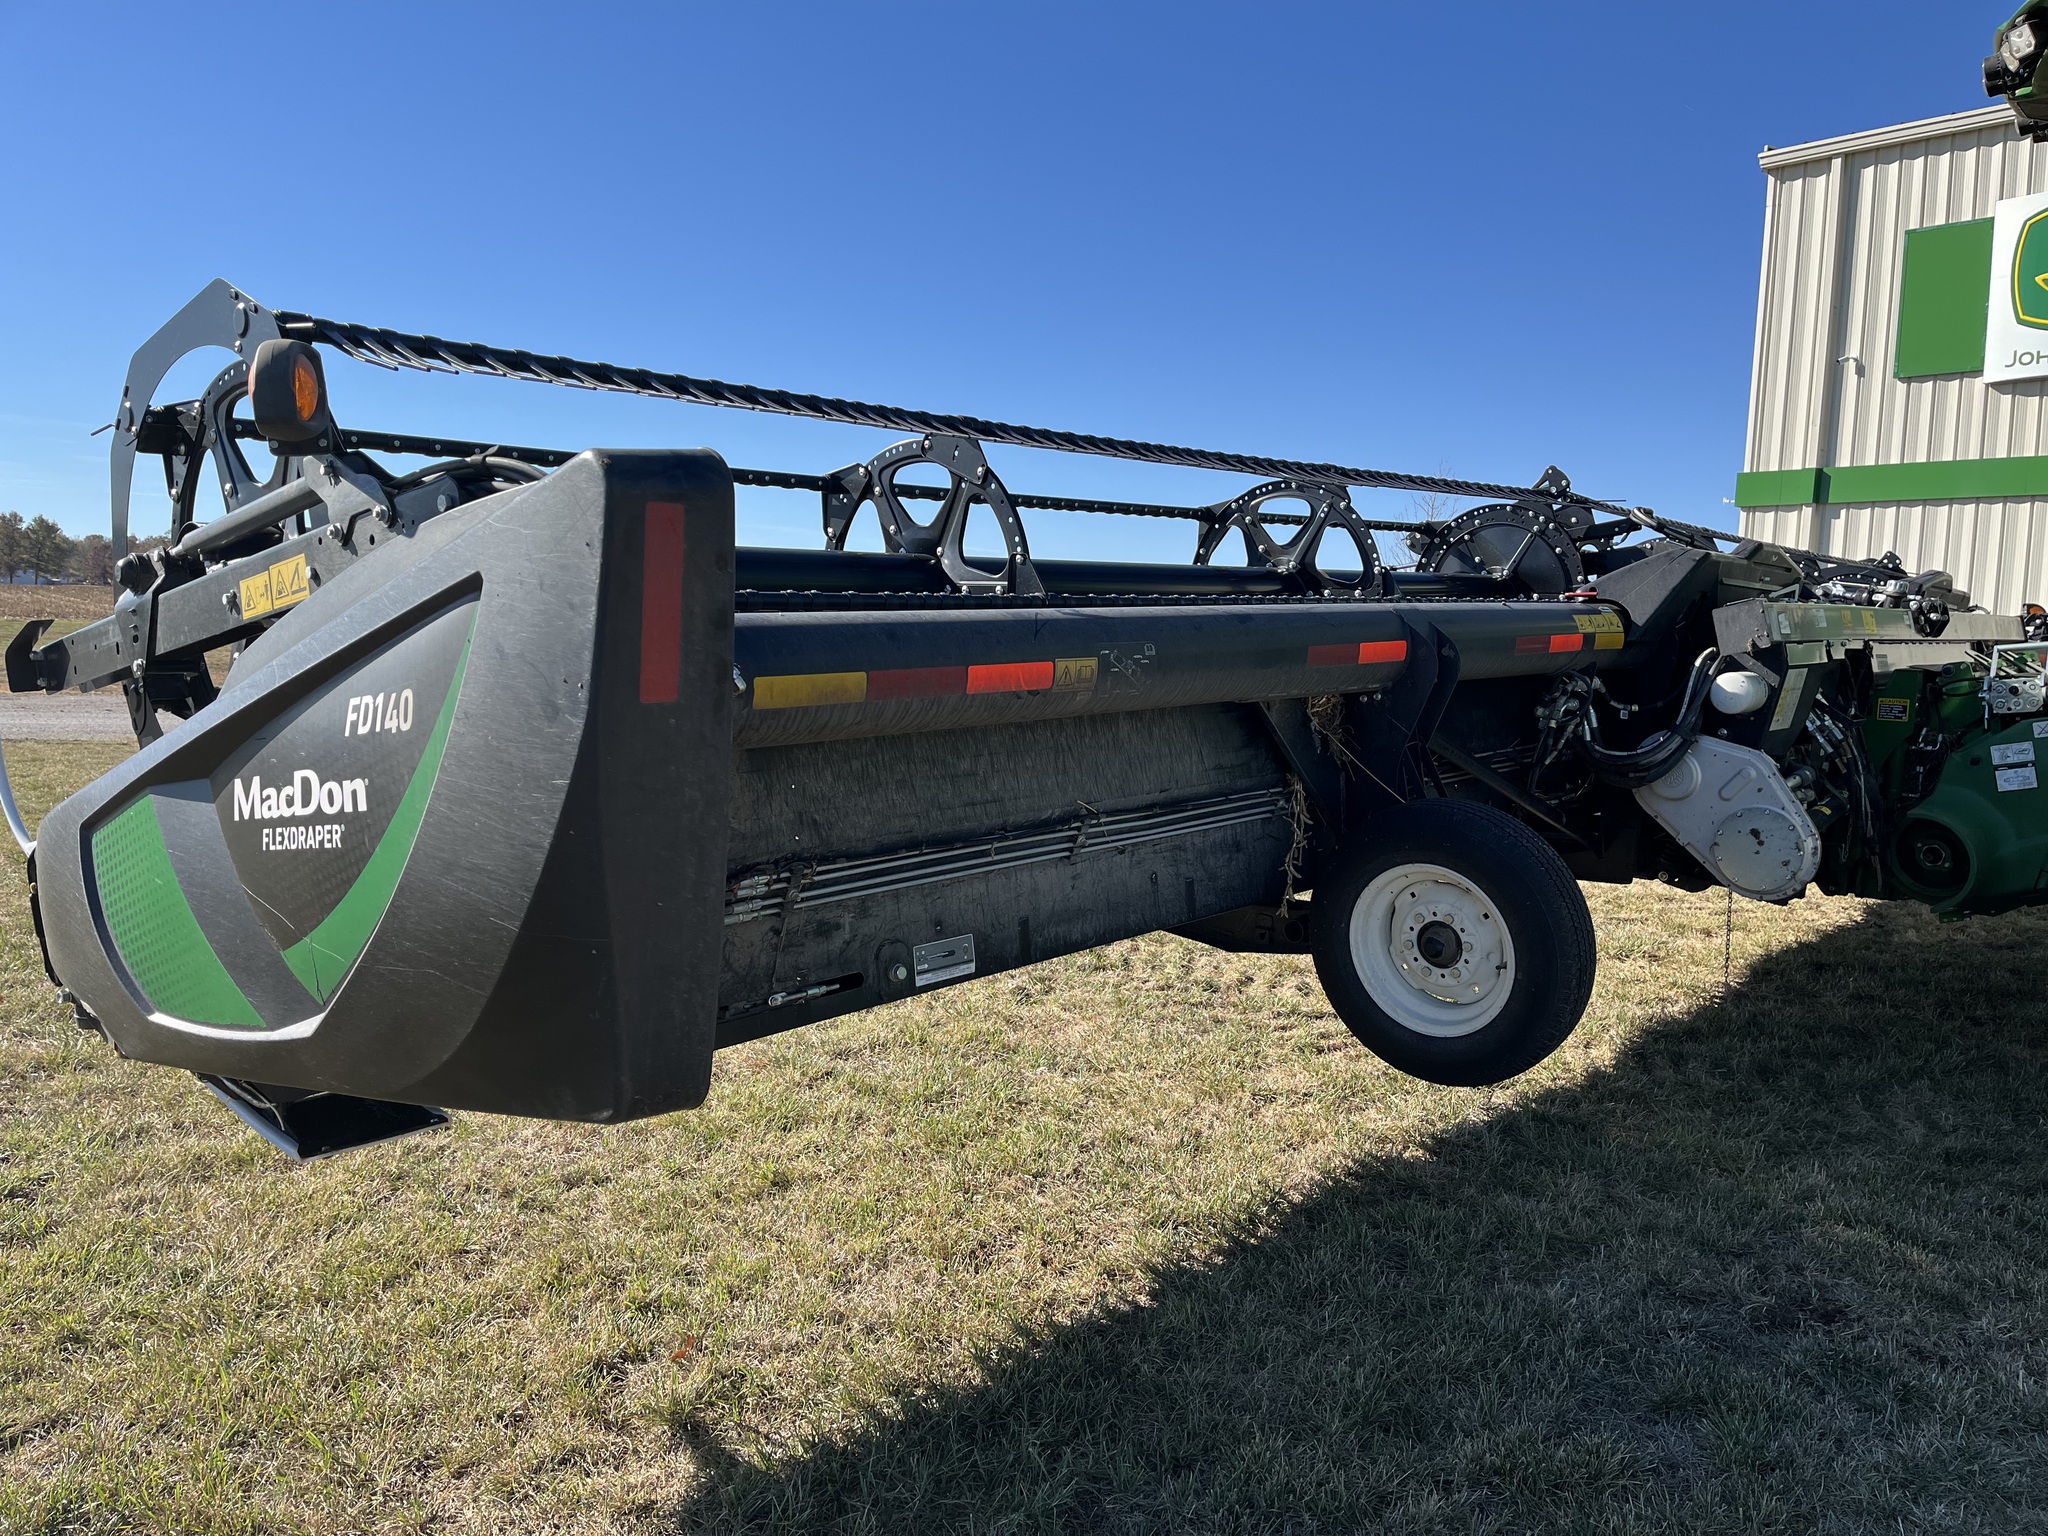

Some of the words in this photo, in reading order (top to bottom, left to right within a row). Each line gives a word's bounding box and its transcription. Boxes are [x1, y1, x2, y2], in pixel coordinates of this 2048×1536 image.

[344, 688, 414, 737] FD140
[233, 768, 368, 821] MacDon
[262, 824, 342, 851] FLEXDRAPER
